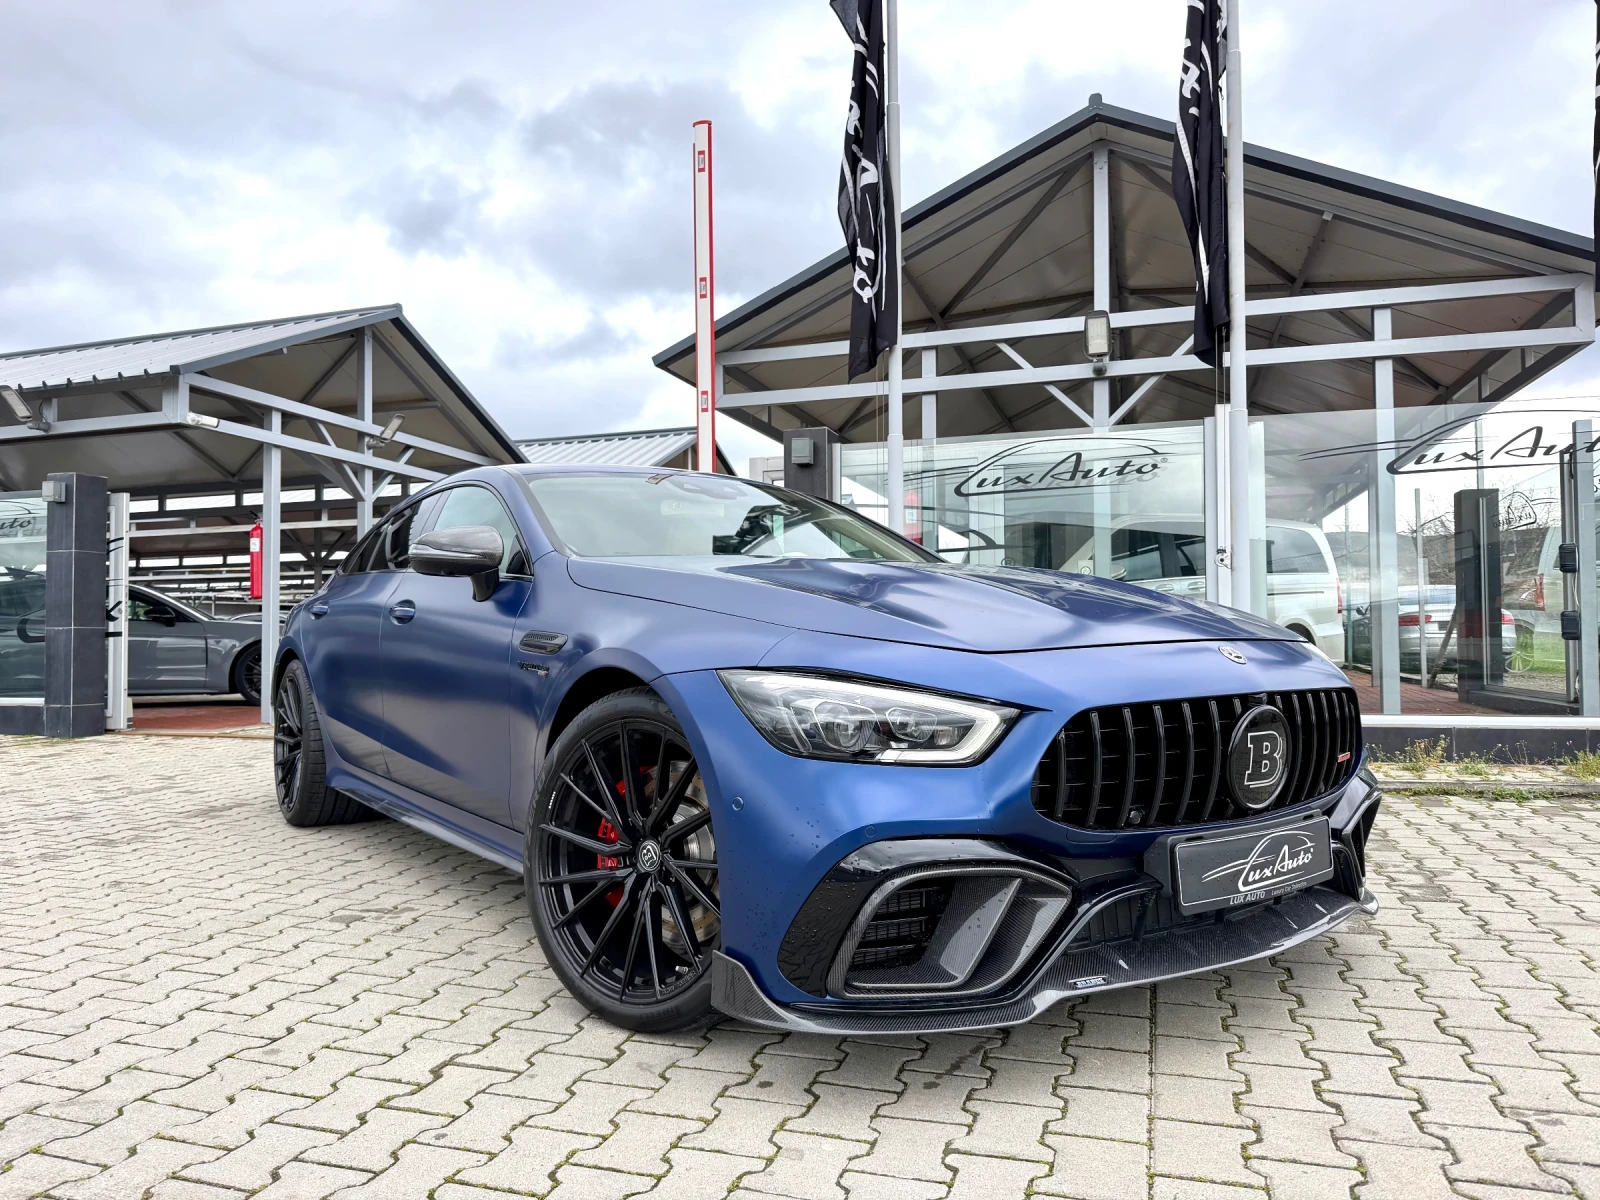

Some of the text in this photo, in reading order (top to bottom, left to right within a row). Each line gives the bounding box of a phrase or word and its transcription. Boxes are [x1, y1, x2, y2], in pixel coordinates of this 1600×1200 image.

[1038, 452, 1161, 483] Auto
[1244, 731, 1283, 787] B
[1273, 845, 1314, 876] Auto
[1229, 891, 1266, 905] LUX AUTO
